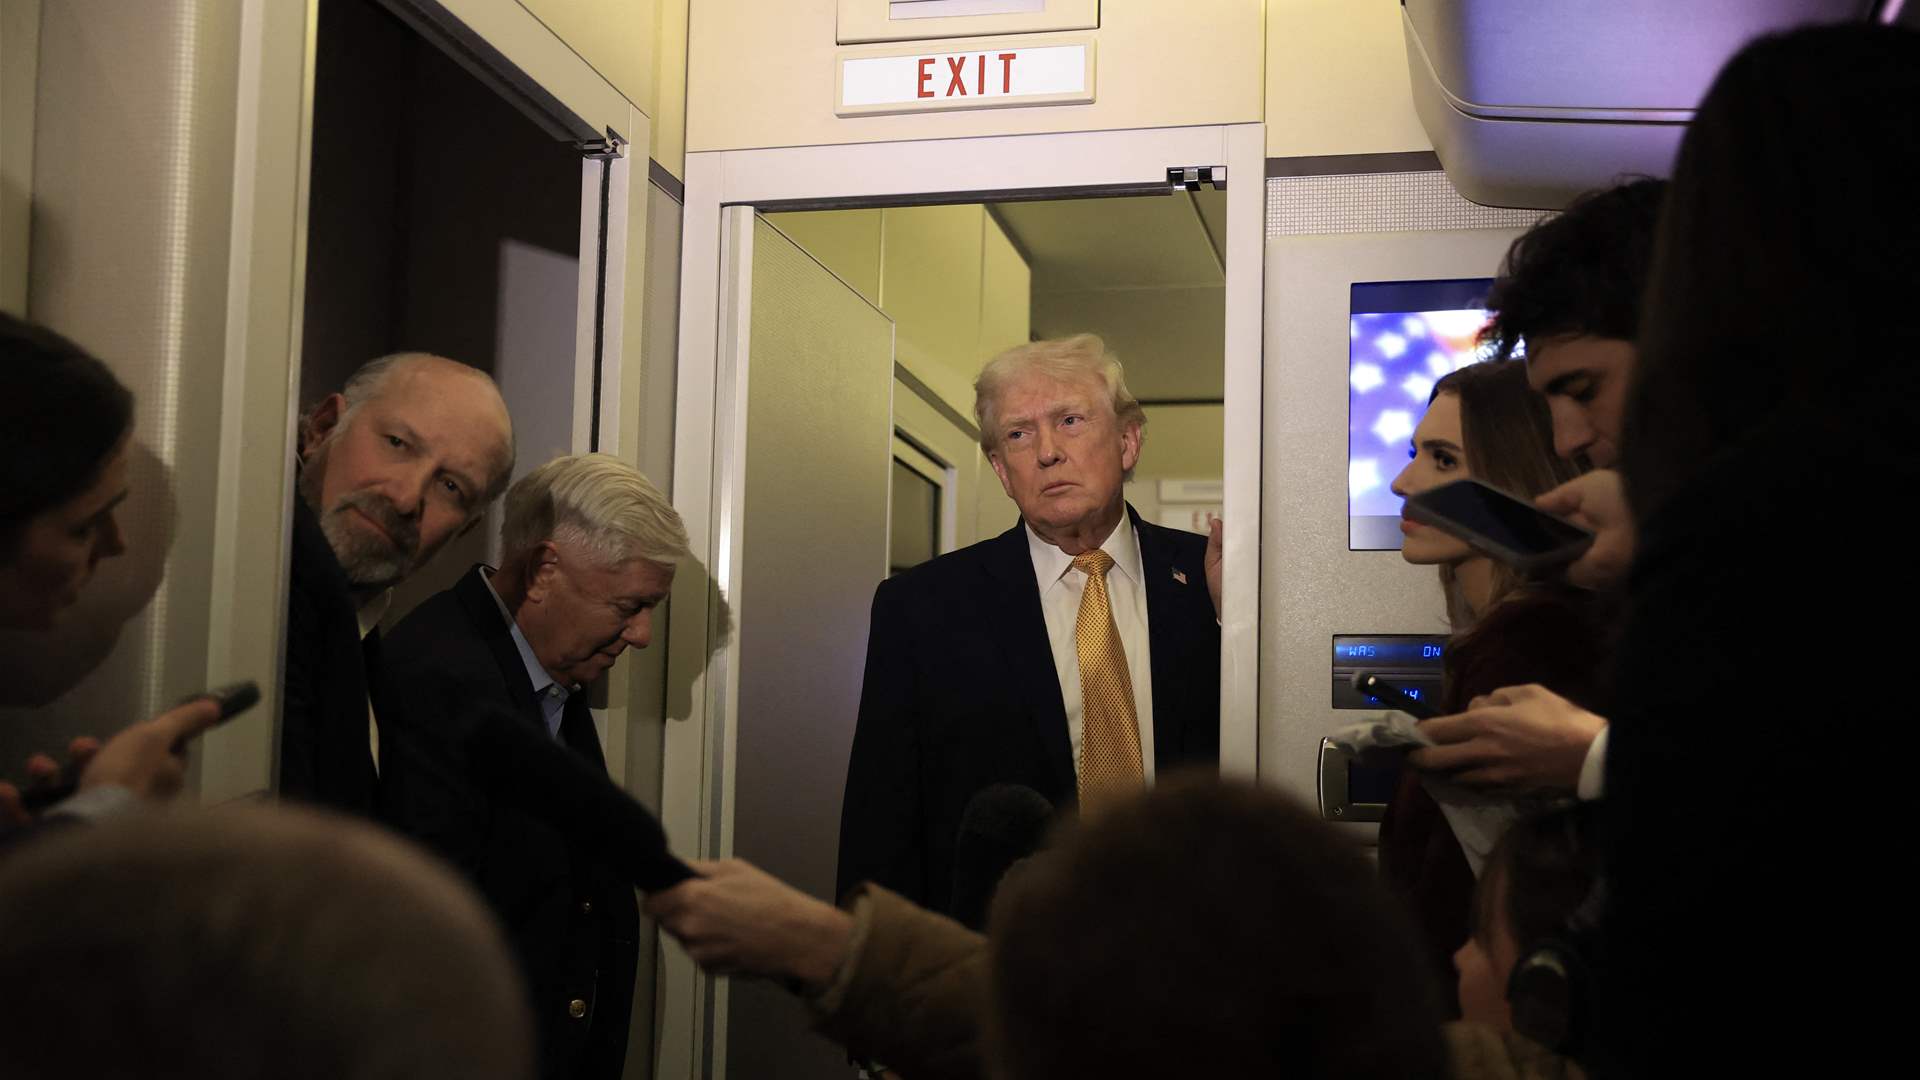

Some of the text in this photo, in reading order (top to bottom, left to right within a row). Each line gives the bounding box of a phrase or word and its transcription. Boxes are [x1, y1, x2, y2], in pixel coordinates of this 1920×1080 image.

[917, 53, 1016, 98] EXIT
[1349, 645, 1441, 657] WAS ON
